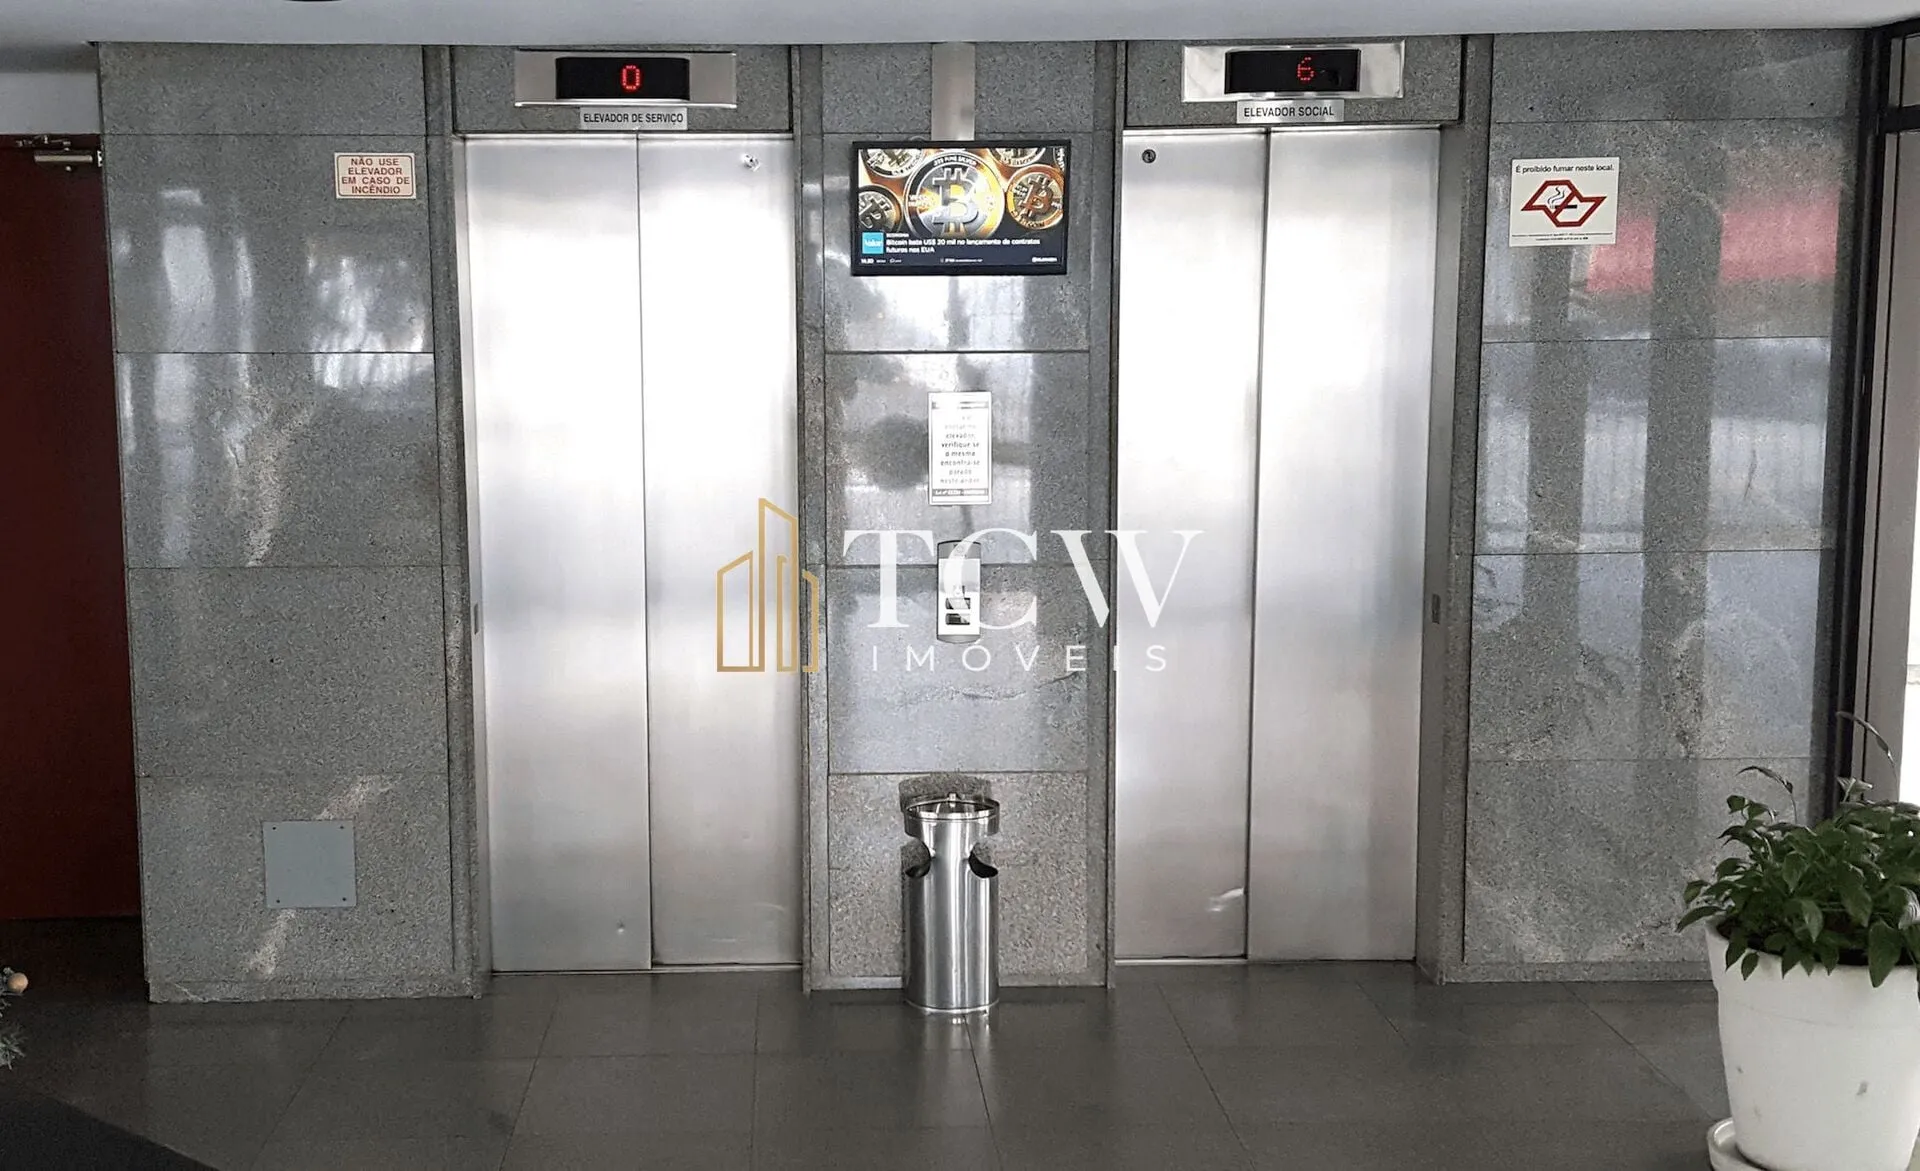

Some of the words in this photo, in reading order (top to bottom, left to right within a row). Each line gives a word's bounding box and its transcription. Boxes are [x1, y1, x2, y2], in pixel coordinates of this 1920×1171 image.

[1296, 56, 1315, 82] 6
[621, 64, 640, 90] 0
[1243, 106, 1296, 118] ELEVADOR
[1298, 105, 1335, 117] SOCIAL
[583, 112, 629, 123] ELEVADOR
[631, 112, 643, 123] DE
[645, 112, 684, 125] SERVIÇO
[350, 156, 373, 166] NÃO
[378, 157, 400, 166] USE
[347, 167, 403, 176] ELEVADOR
[1515, 165, 1521, 173] É
[1522, 165, 1551, 174] proibido
[1575, 164, 1595, 172] neste
[1596, 163, 1615, 171] local.
[341, 176, 357, 185] EM
[361, 176, 391, 185] CASO
[396, 176, 411, 185] DE
[351, 184, 401, 194] INCÊNDIO
[886, 238, 908, 246] Bitcoin
[946, 238, 957, 246] mil
